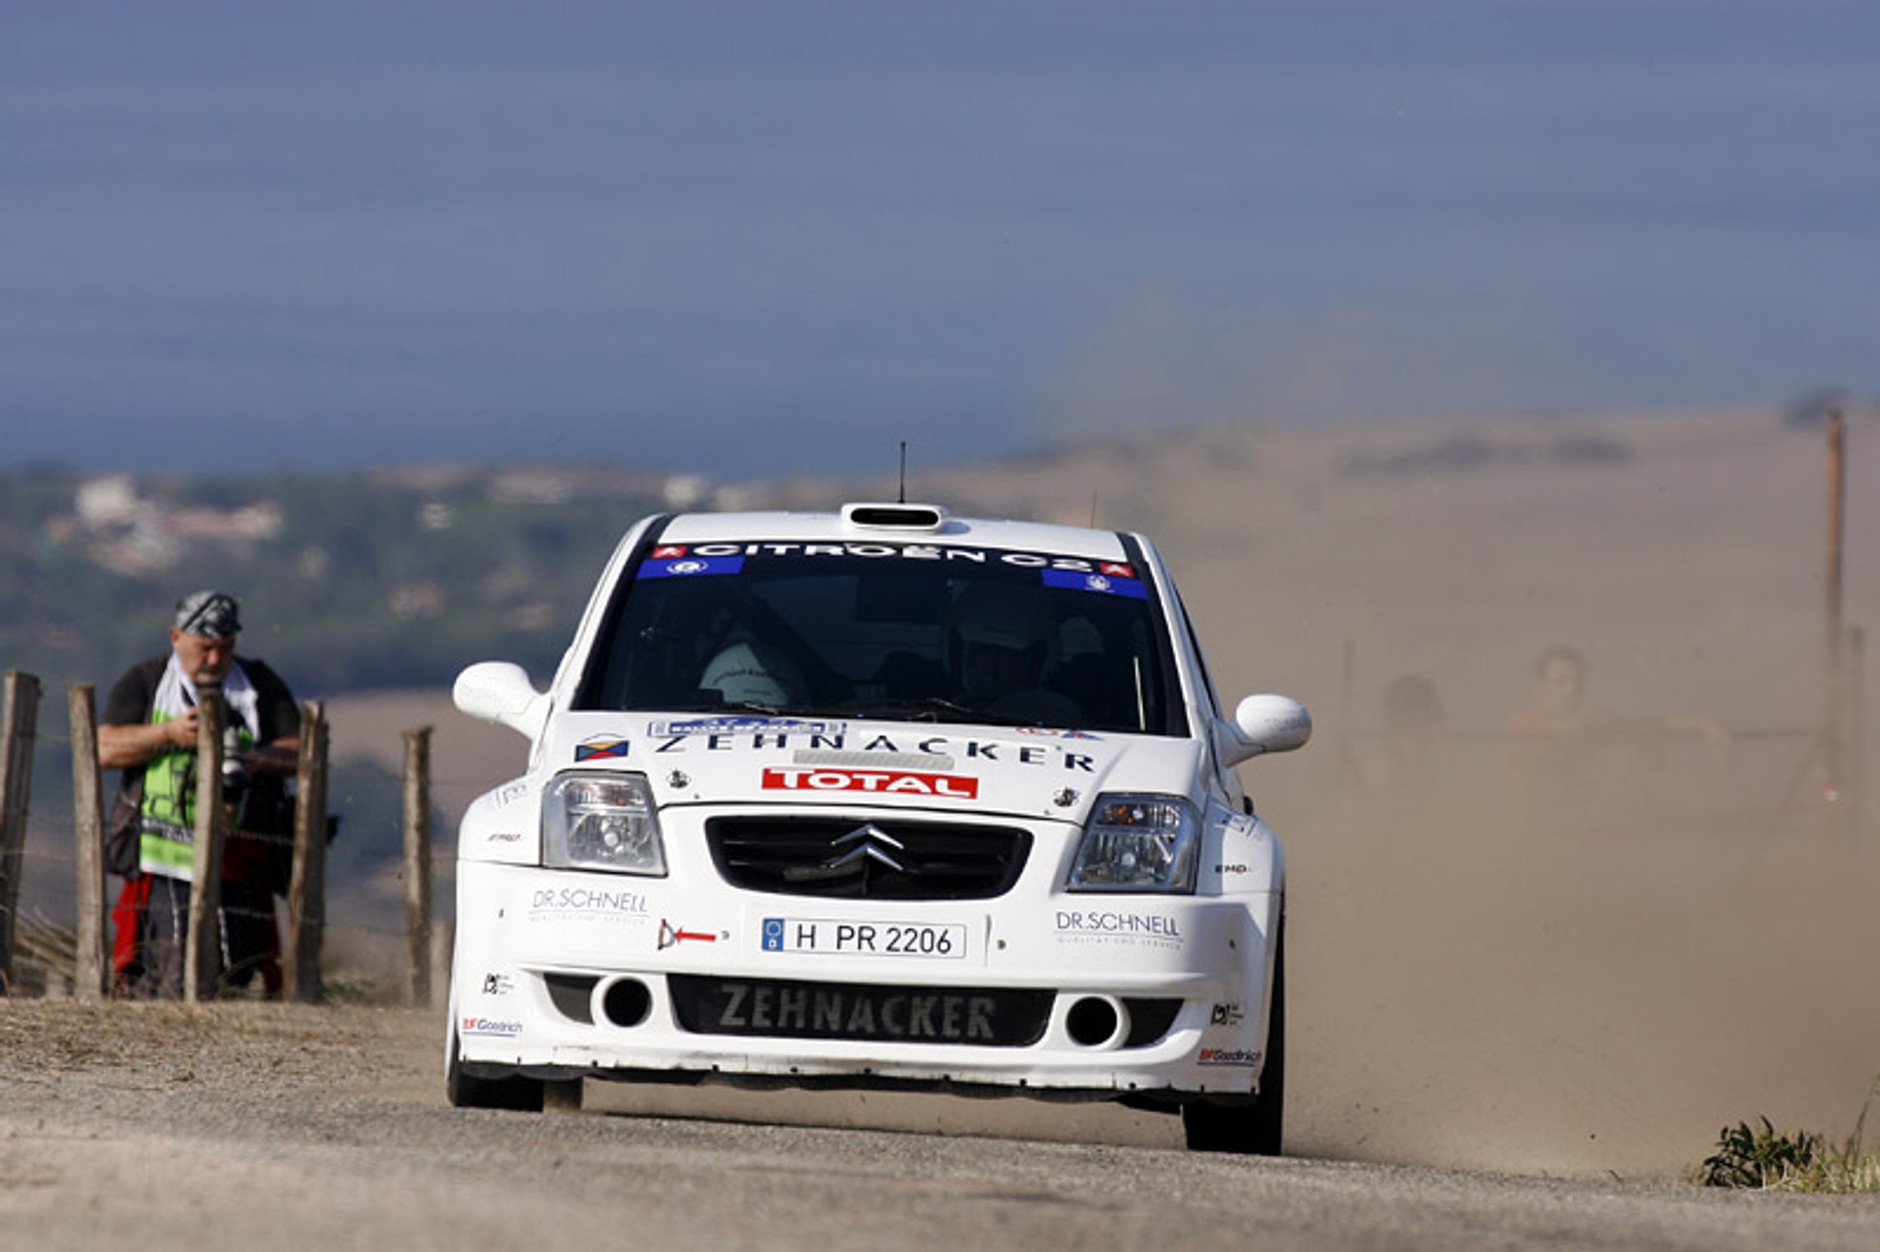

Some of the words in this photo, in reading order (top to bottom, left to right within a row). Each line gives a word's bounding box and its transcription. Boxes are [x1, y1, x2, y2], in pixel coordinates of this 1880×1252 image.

[1001, 554, 1093, 572] C2
[656, 733, 1095, 773] ZEHNACKER
[770, 767, 971, 797] TOTAL
[796, 924, 816, 948] H
[836, 925, 876, 950] PR
[885, 927, 951, 954] 2206
[719, 984, 995, 1038] ZEHNACKER
